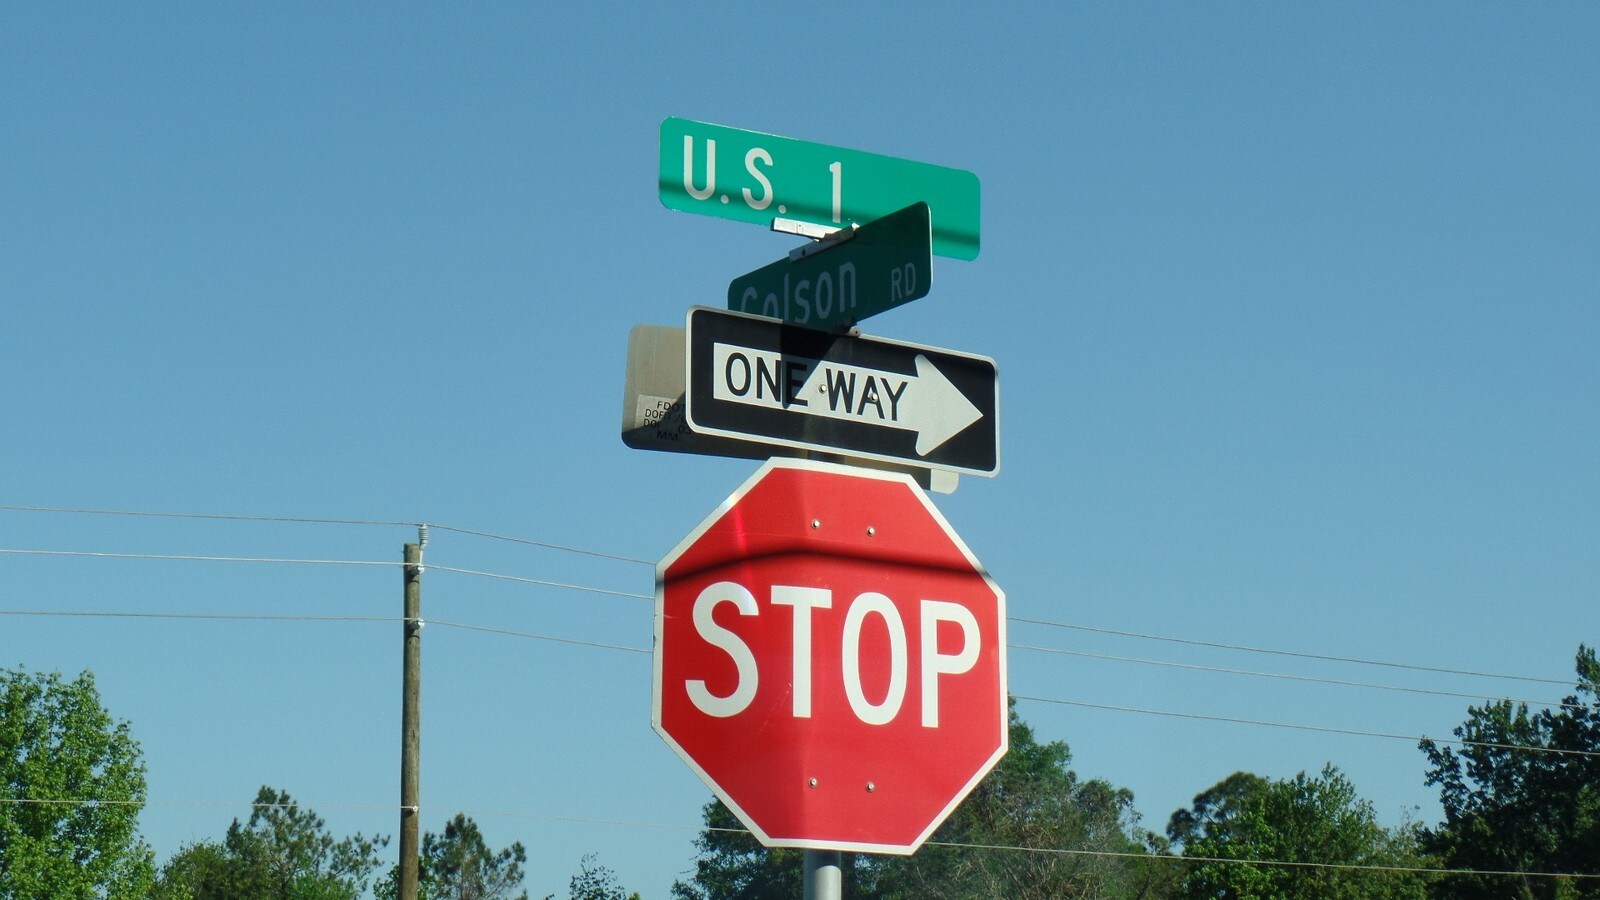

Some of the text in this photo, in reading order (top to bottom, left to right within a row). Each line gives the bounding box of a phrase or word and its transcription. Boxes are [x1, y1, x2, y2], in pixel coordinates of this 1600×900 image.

[683, 134, 842, 224] U.S. 1
[891, 262, 917, 302] RD
[725, 352, 909, 422] ONE WAY
[685, 581, 981, 729] STOP
